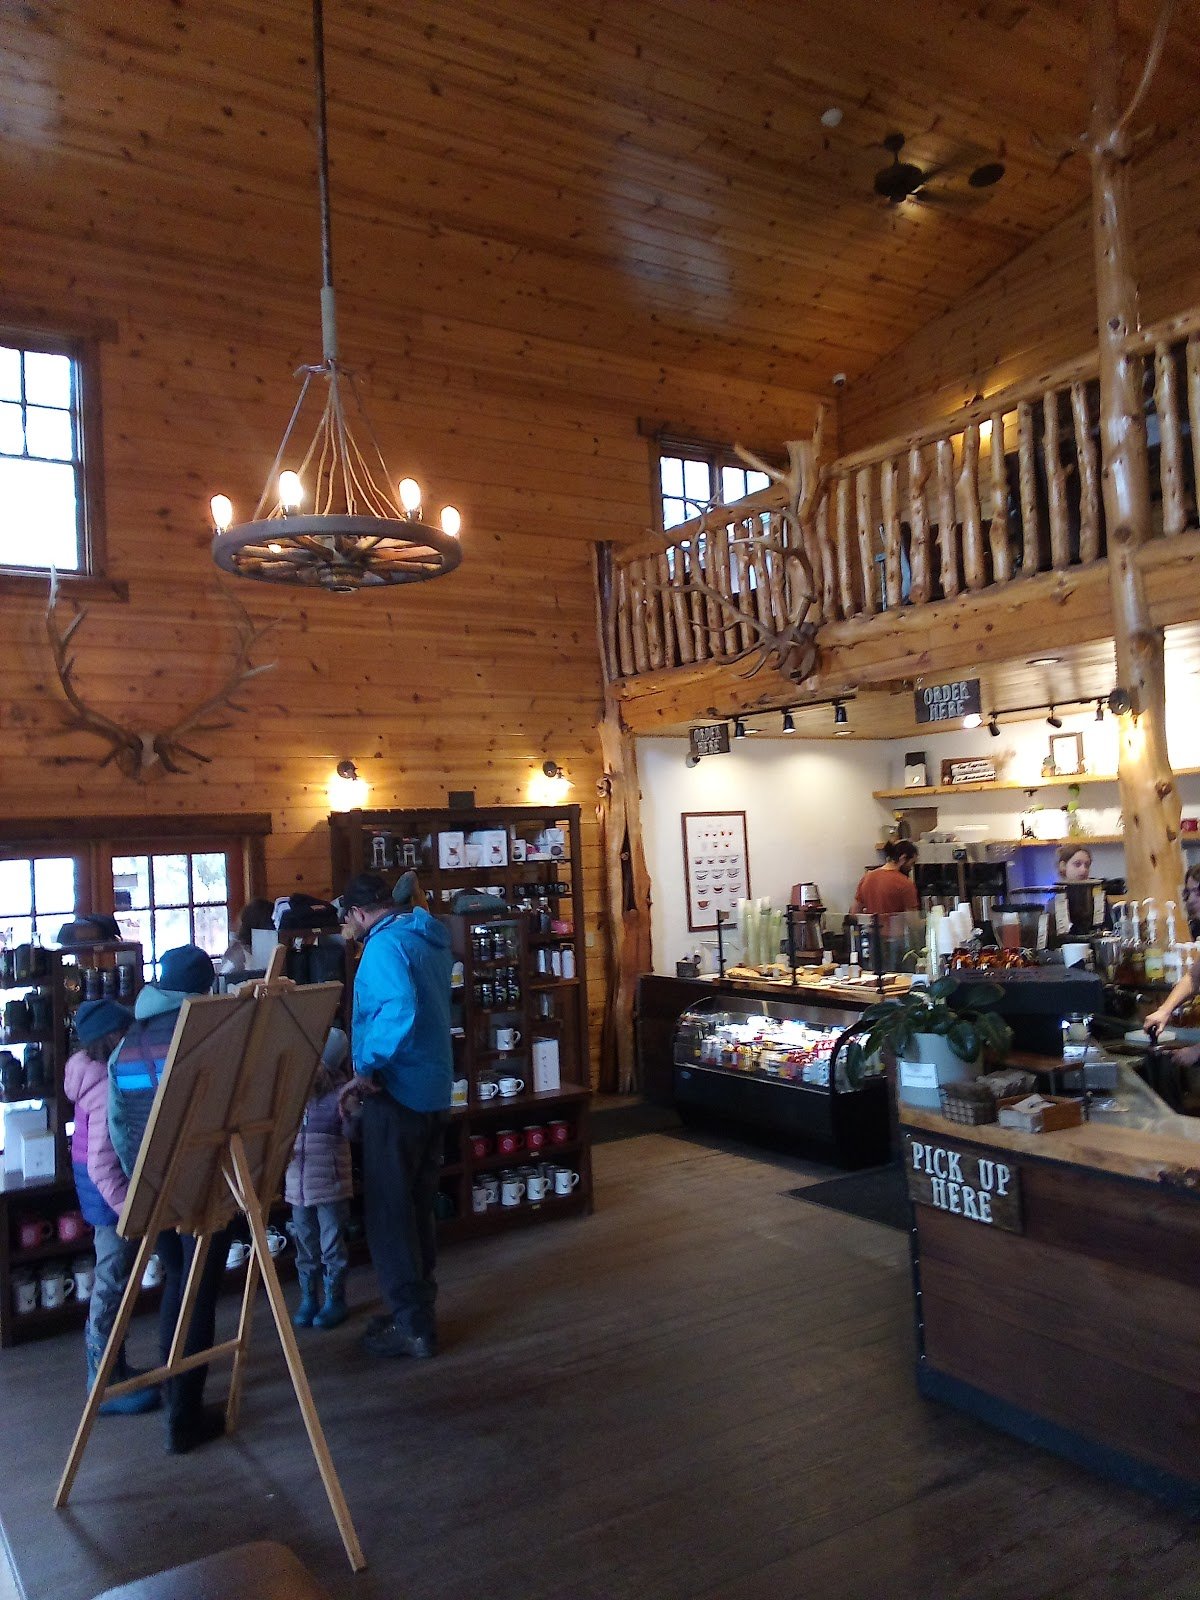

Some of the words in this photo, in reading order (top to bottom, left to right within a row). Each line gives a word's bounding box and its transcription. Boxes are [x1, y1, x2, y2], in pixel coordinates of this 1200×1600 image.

[923, 681, 970, 705] ORDER
[929, 699, 965, 721] HERE
[694, 725, 722, 741] ORDER
[697, 738, 720, 754] HERE
[911, 1142, 965, 1183] PICK
[977, 1159, 1010, 1195] UP
[930, 1177, 993, 1223] HERE
